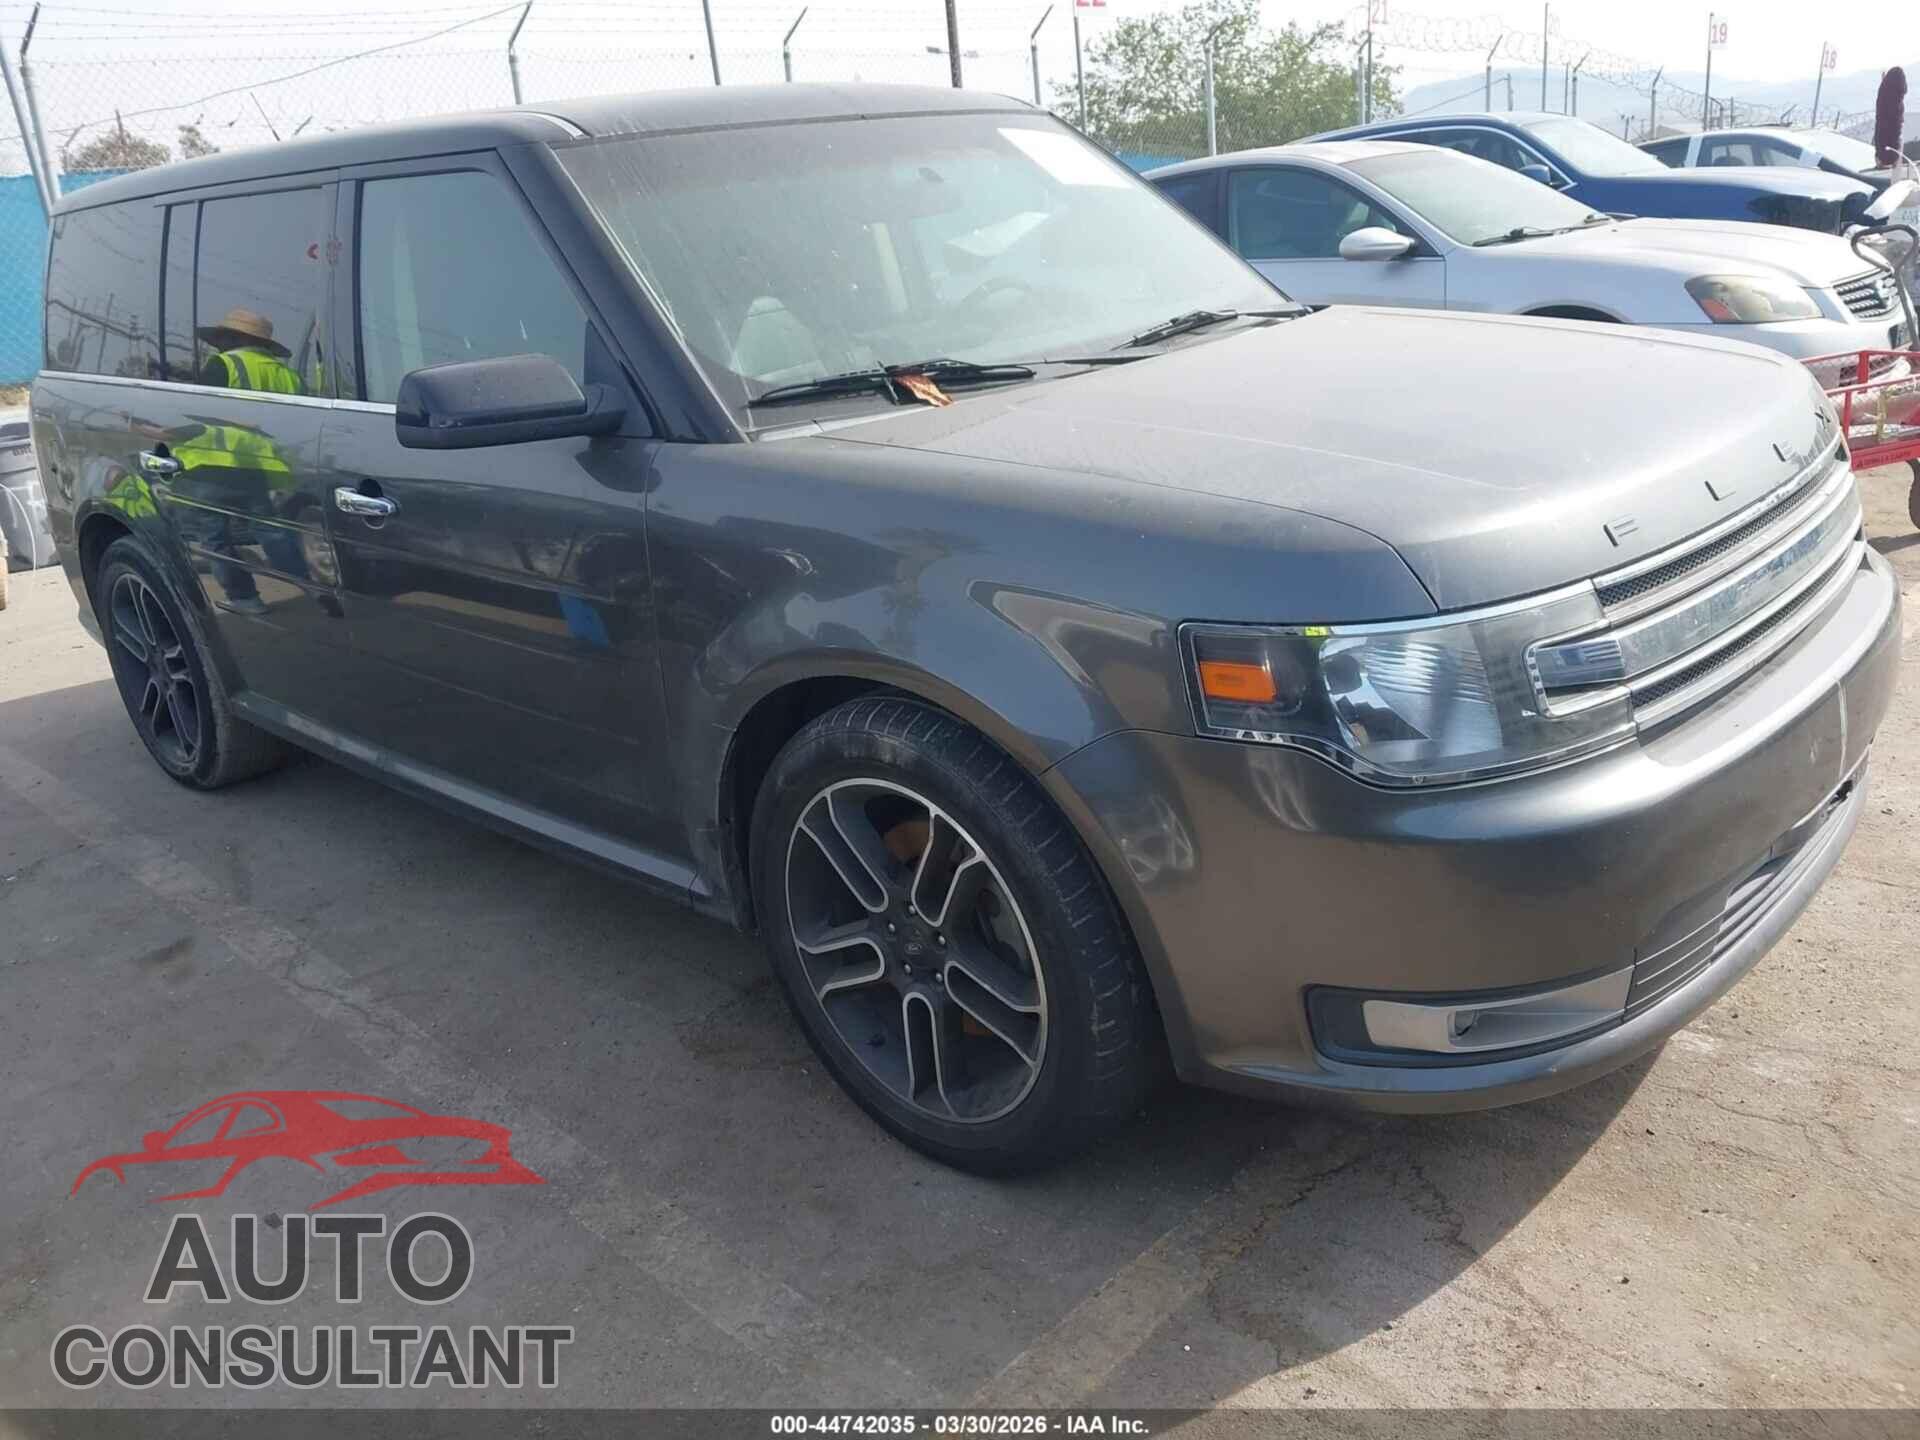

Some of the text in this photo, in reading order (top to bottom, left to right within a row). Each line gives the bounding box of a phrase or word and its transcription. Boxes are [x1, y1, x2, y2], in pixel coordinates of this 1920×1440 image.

[1711, 22, 1728, 44] 19
[1823, 49, 1838, 70] 18
[1602, 406, 1831, 547] FLEX
